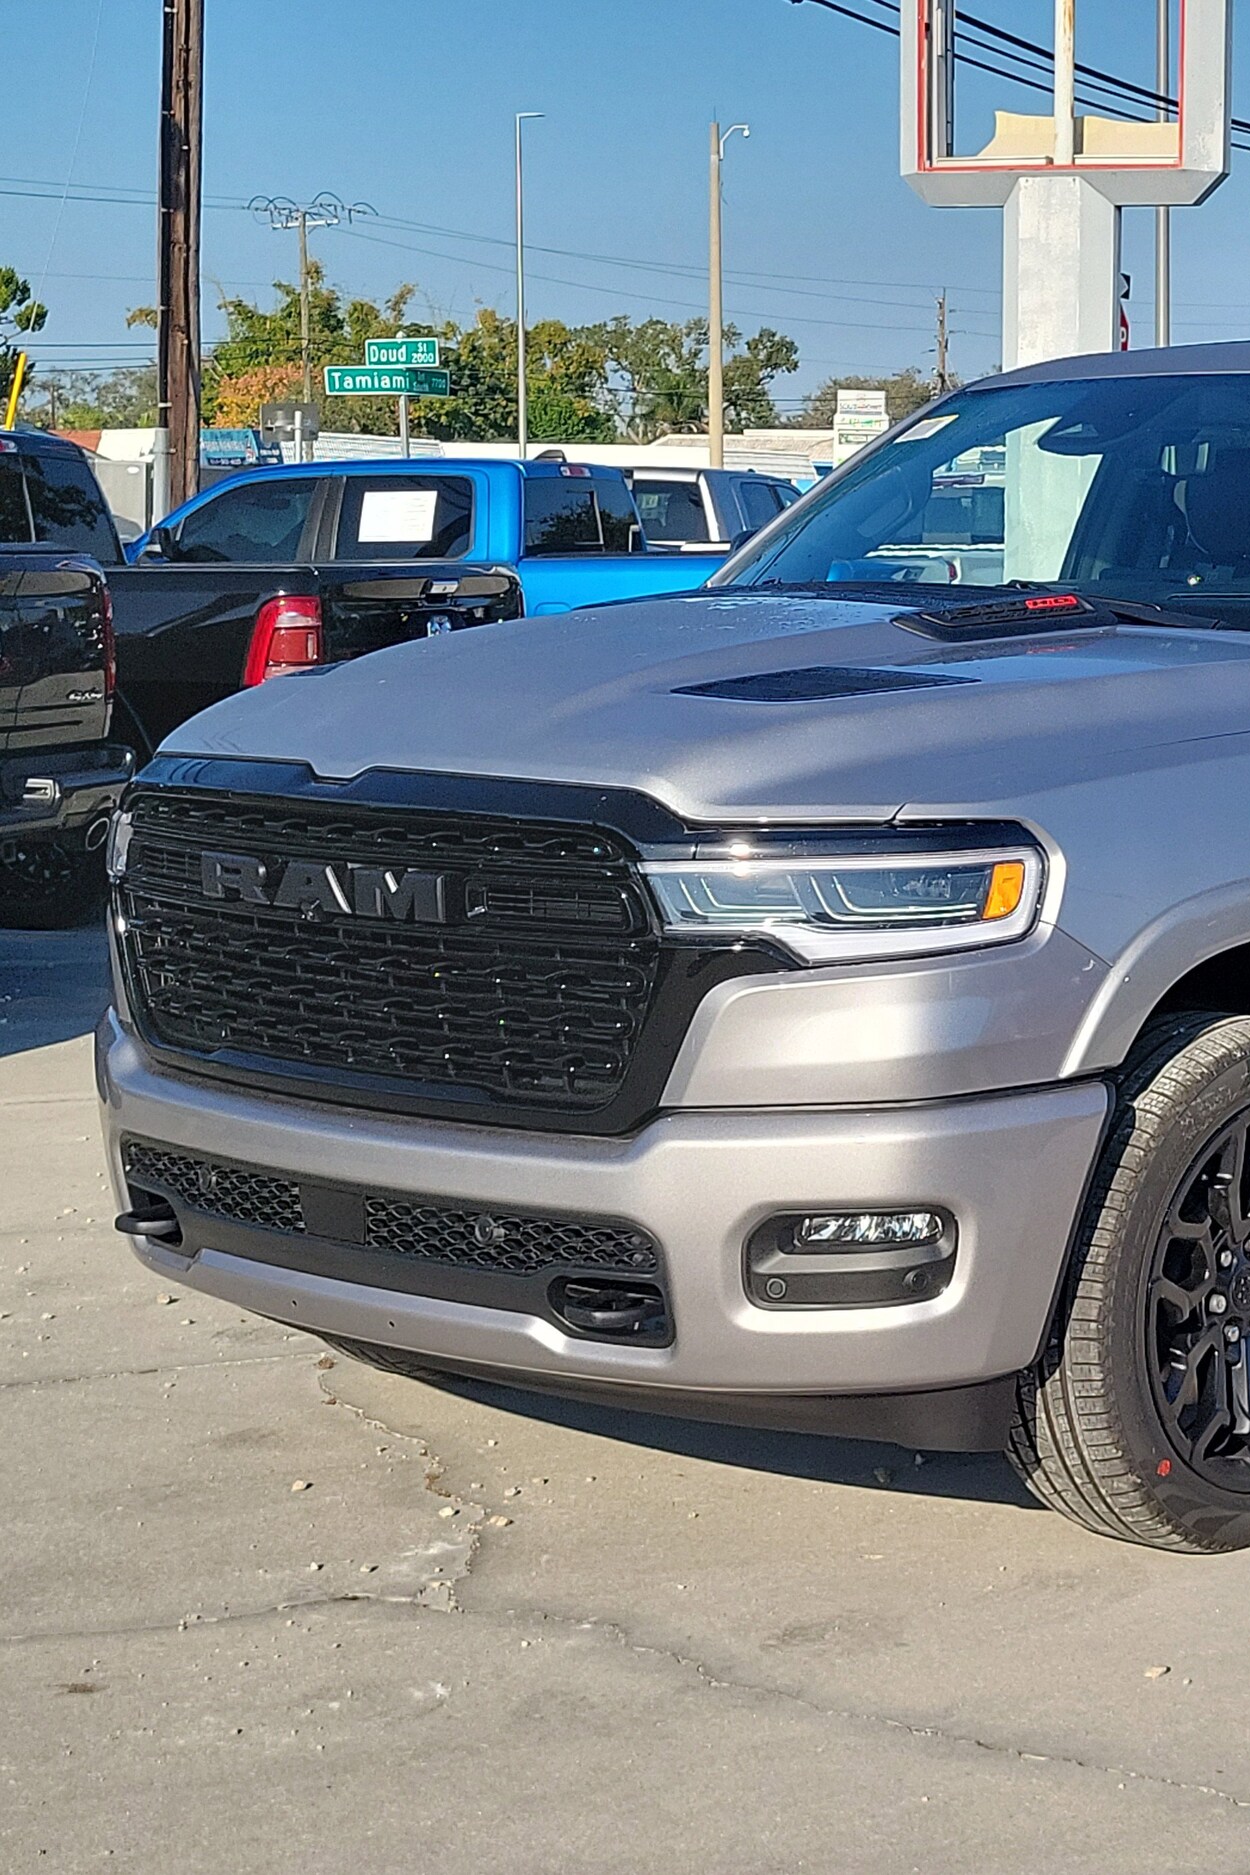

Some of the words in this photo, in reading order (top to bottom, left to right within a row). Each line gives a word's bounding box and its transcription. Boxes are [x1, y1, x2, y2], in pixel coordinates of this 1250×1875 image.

[370, 344, 407, 363] Doud
[411, 353, 434, 363] 2000
[331, 371, 410, 390] Tamiami
[201, 851, 446, 923] RAM
